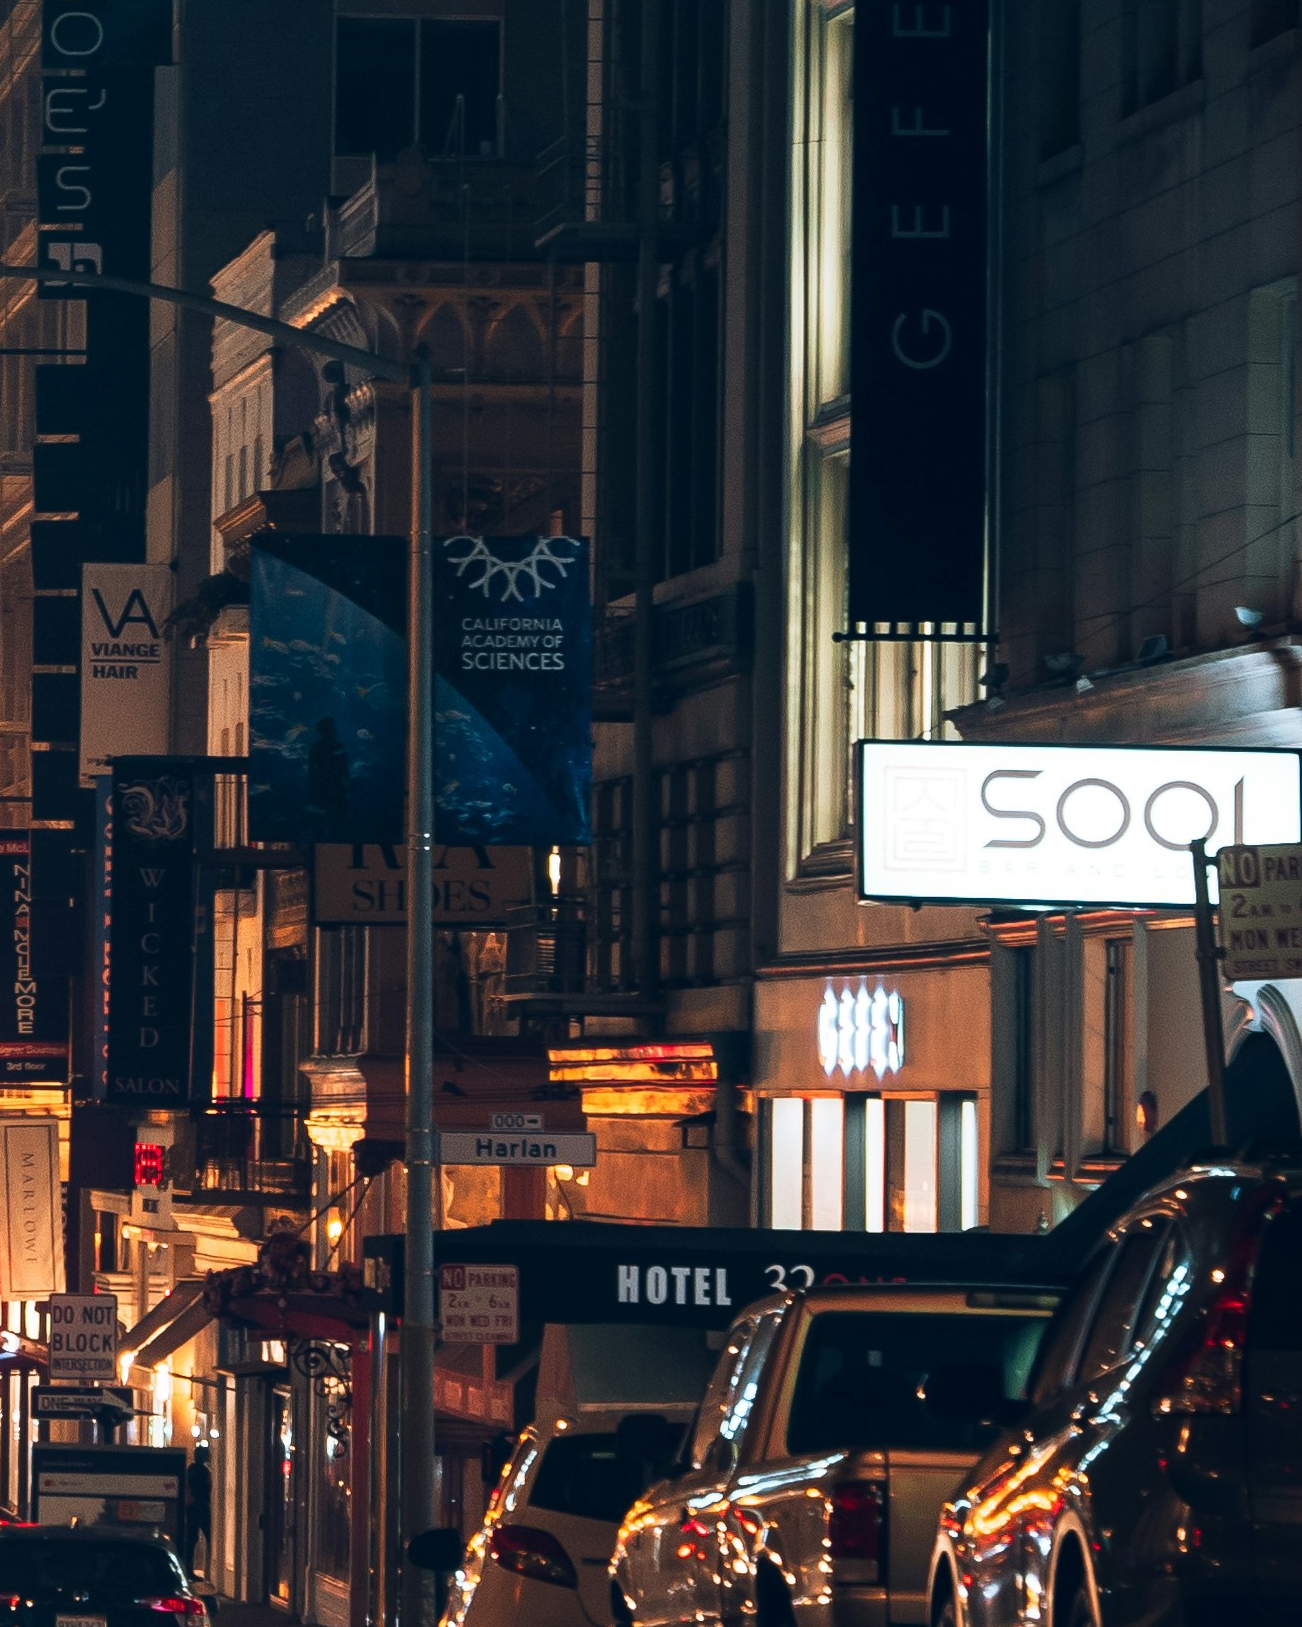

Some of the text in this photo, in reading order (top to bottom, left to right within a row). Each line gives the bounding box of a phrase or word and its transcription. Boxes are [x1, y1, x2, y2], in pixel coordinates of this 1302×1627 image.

[91, 588, 160, 639] VA
[461, 617, 564, 631] CALIFORNIA
[91, 642, 160, 658] VIANGE
[461, 634, 565, 648] ACADEMY OF
[461, 652, 566, 671] SCIENCES
[92, 664, 139, 680] HAIR
[1219, 851, 1257, 886] NO
[13, 864, 33, 915] NINA
[352, 879, 492, 914] SHES
[1230, 929, 1269, 951] MON
[139, 869, 166, 1049] WICKED
[6, 1061, 47, 1072] 3rd floor
[115, 1076, 181, 1095] SALON
[475, 1137, 558, 1159] Harlan
[441, 1269, 517, 1289] NO PARKING
[617, 1264, 733, 1306] HOTEL
[51, 1305, 113, 1324] DO NOT
[469, 1315, 491, 1328] WED
[495, 1315, 514, 1328] FRI
[52, 1332, 113, 1352] BLOCK
[52, 1357, 113, 1372] INTERSECTION
[42, 1396, 69, 1410] ONE
